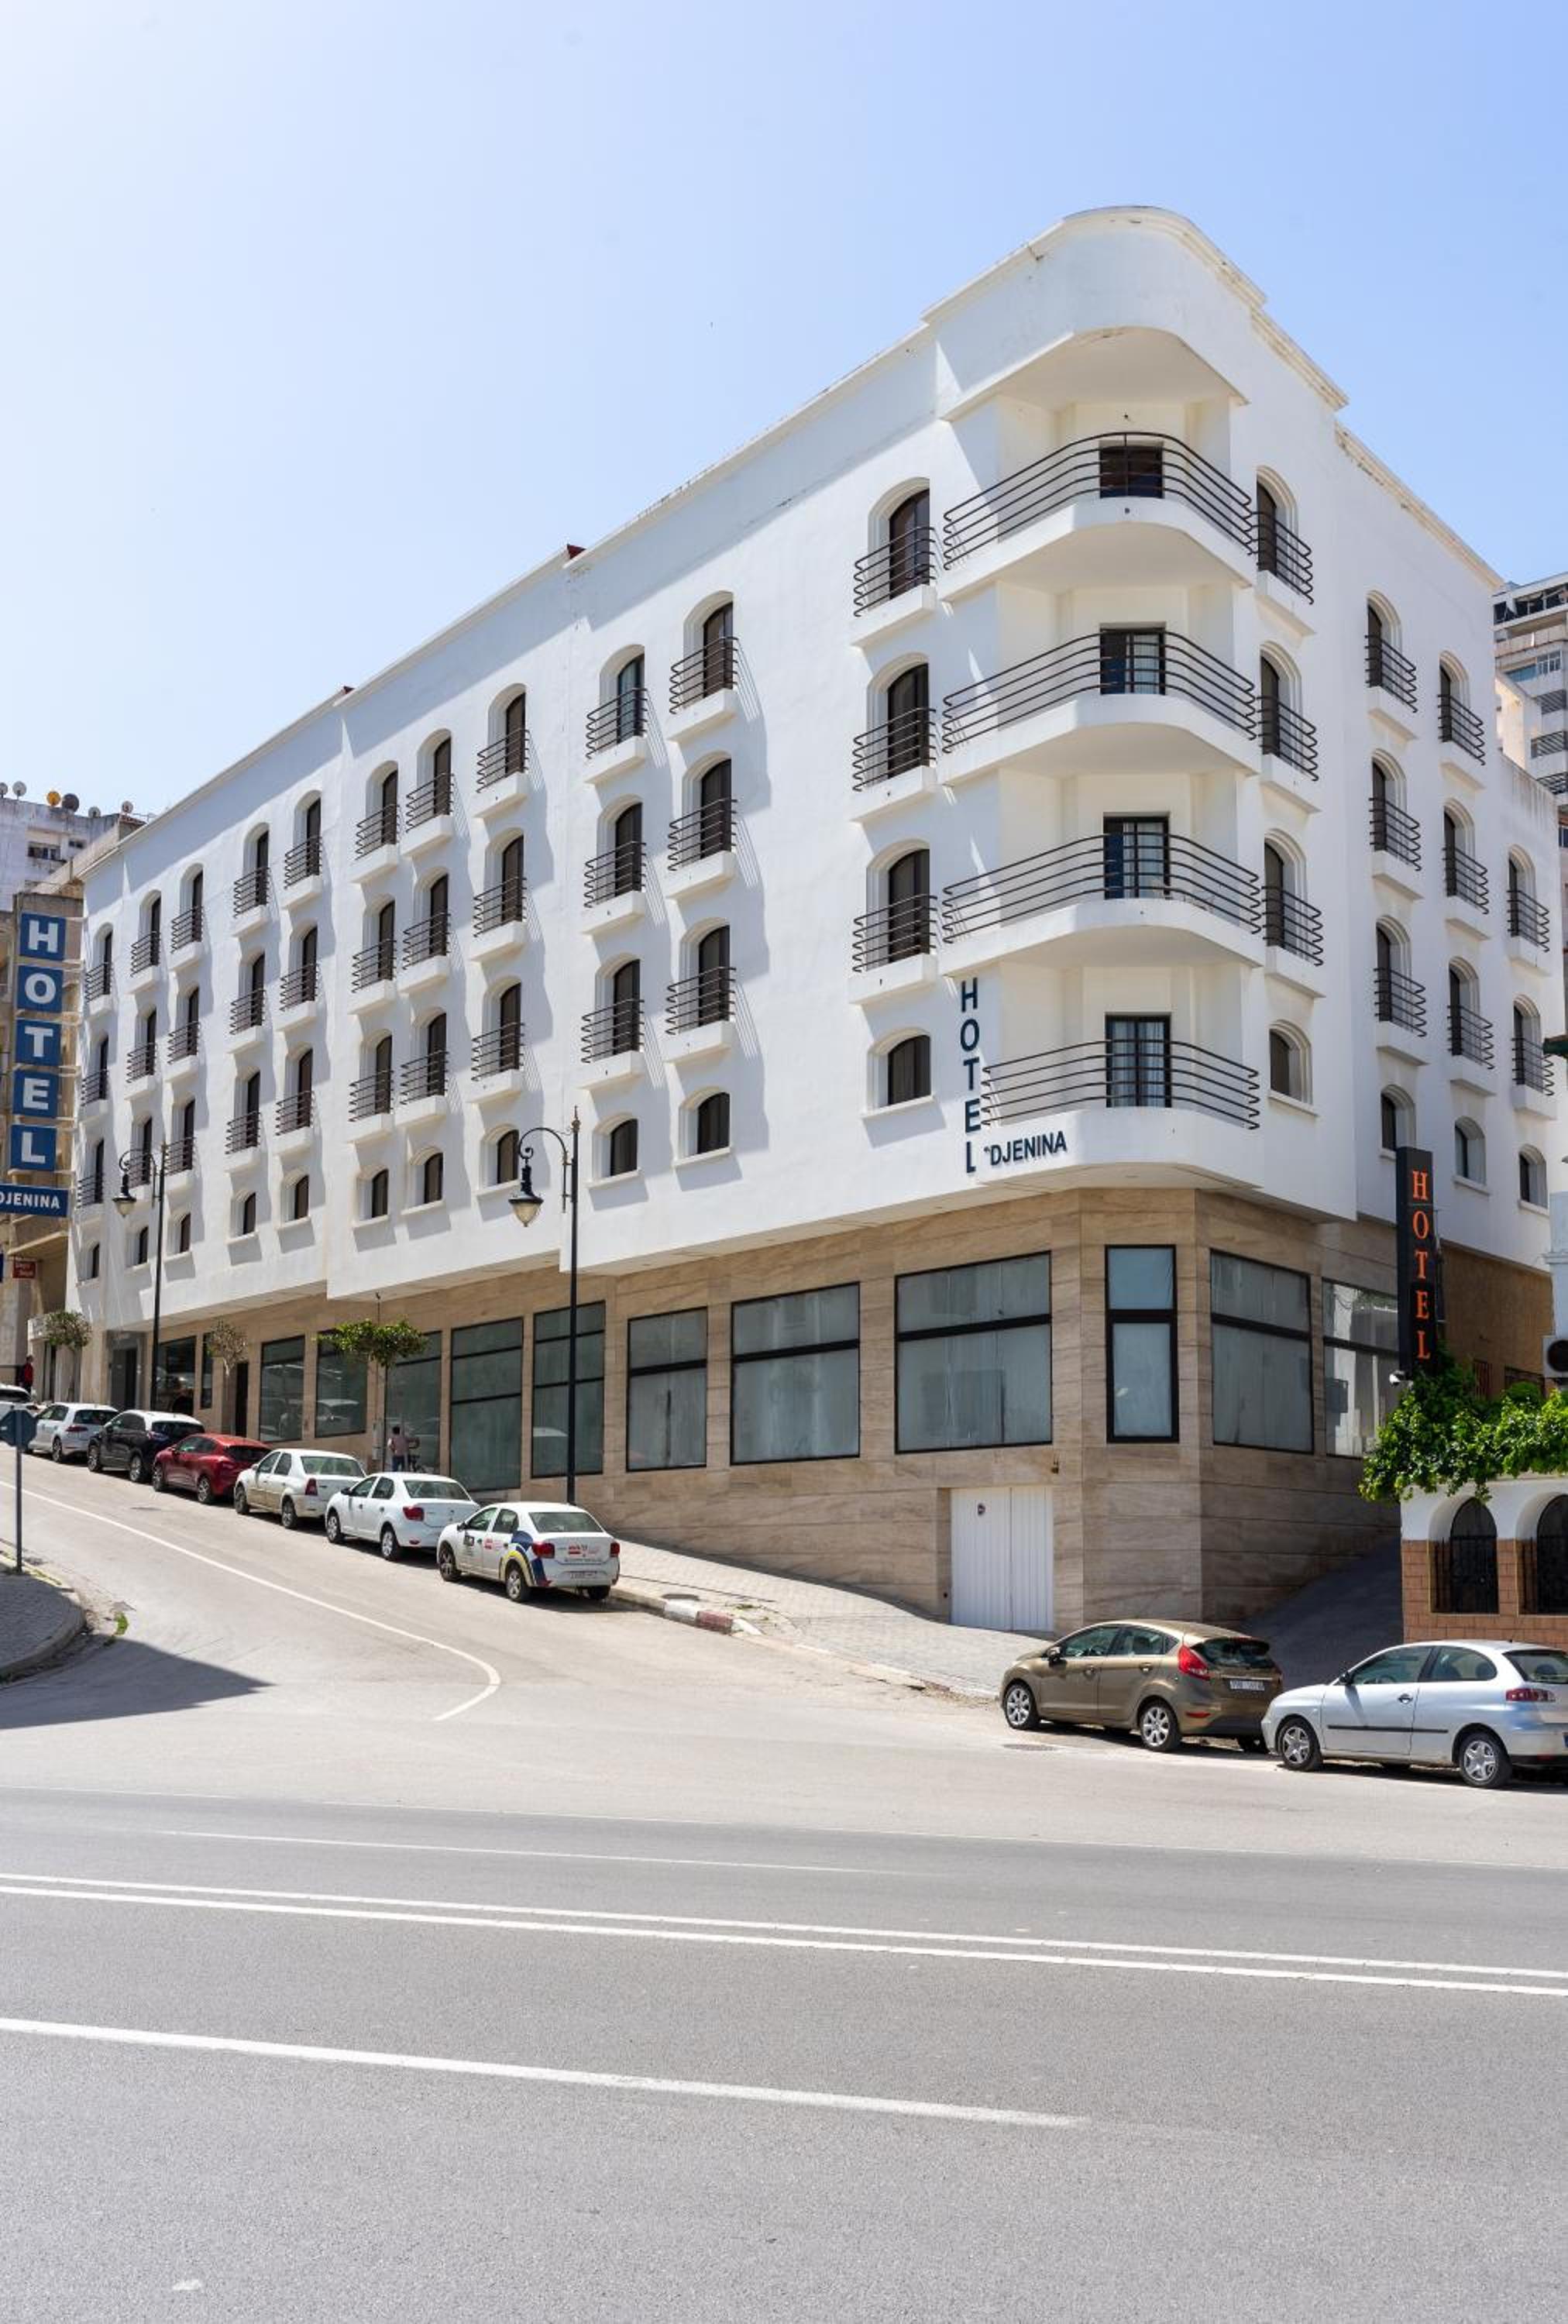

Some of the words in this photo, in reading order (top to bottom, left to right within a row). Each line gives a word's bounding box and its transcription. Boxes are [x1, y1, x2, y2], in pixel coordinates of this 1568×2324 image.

[21, 920, 59, 1164] HOTEL
[960, 977, 981, 1174] HOTEL
[990, 1130, 1068, 1166] DJENINA
[1412, 1171, 1431, 1360] HOTEL
